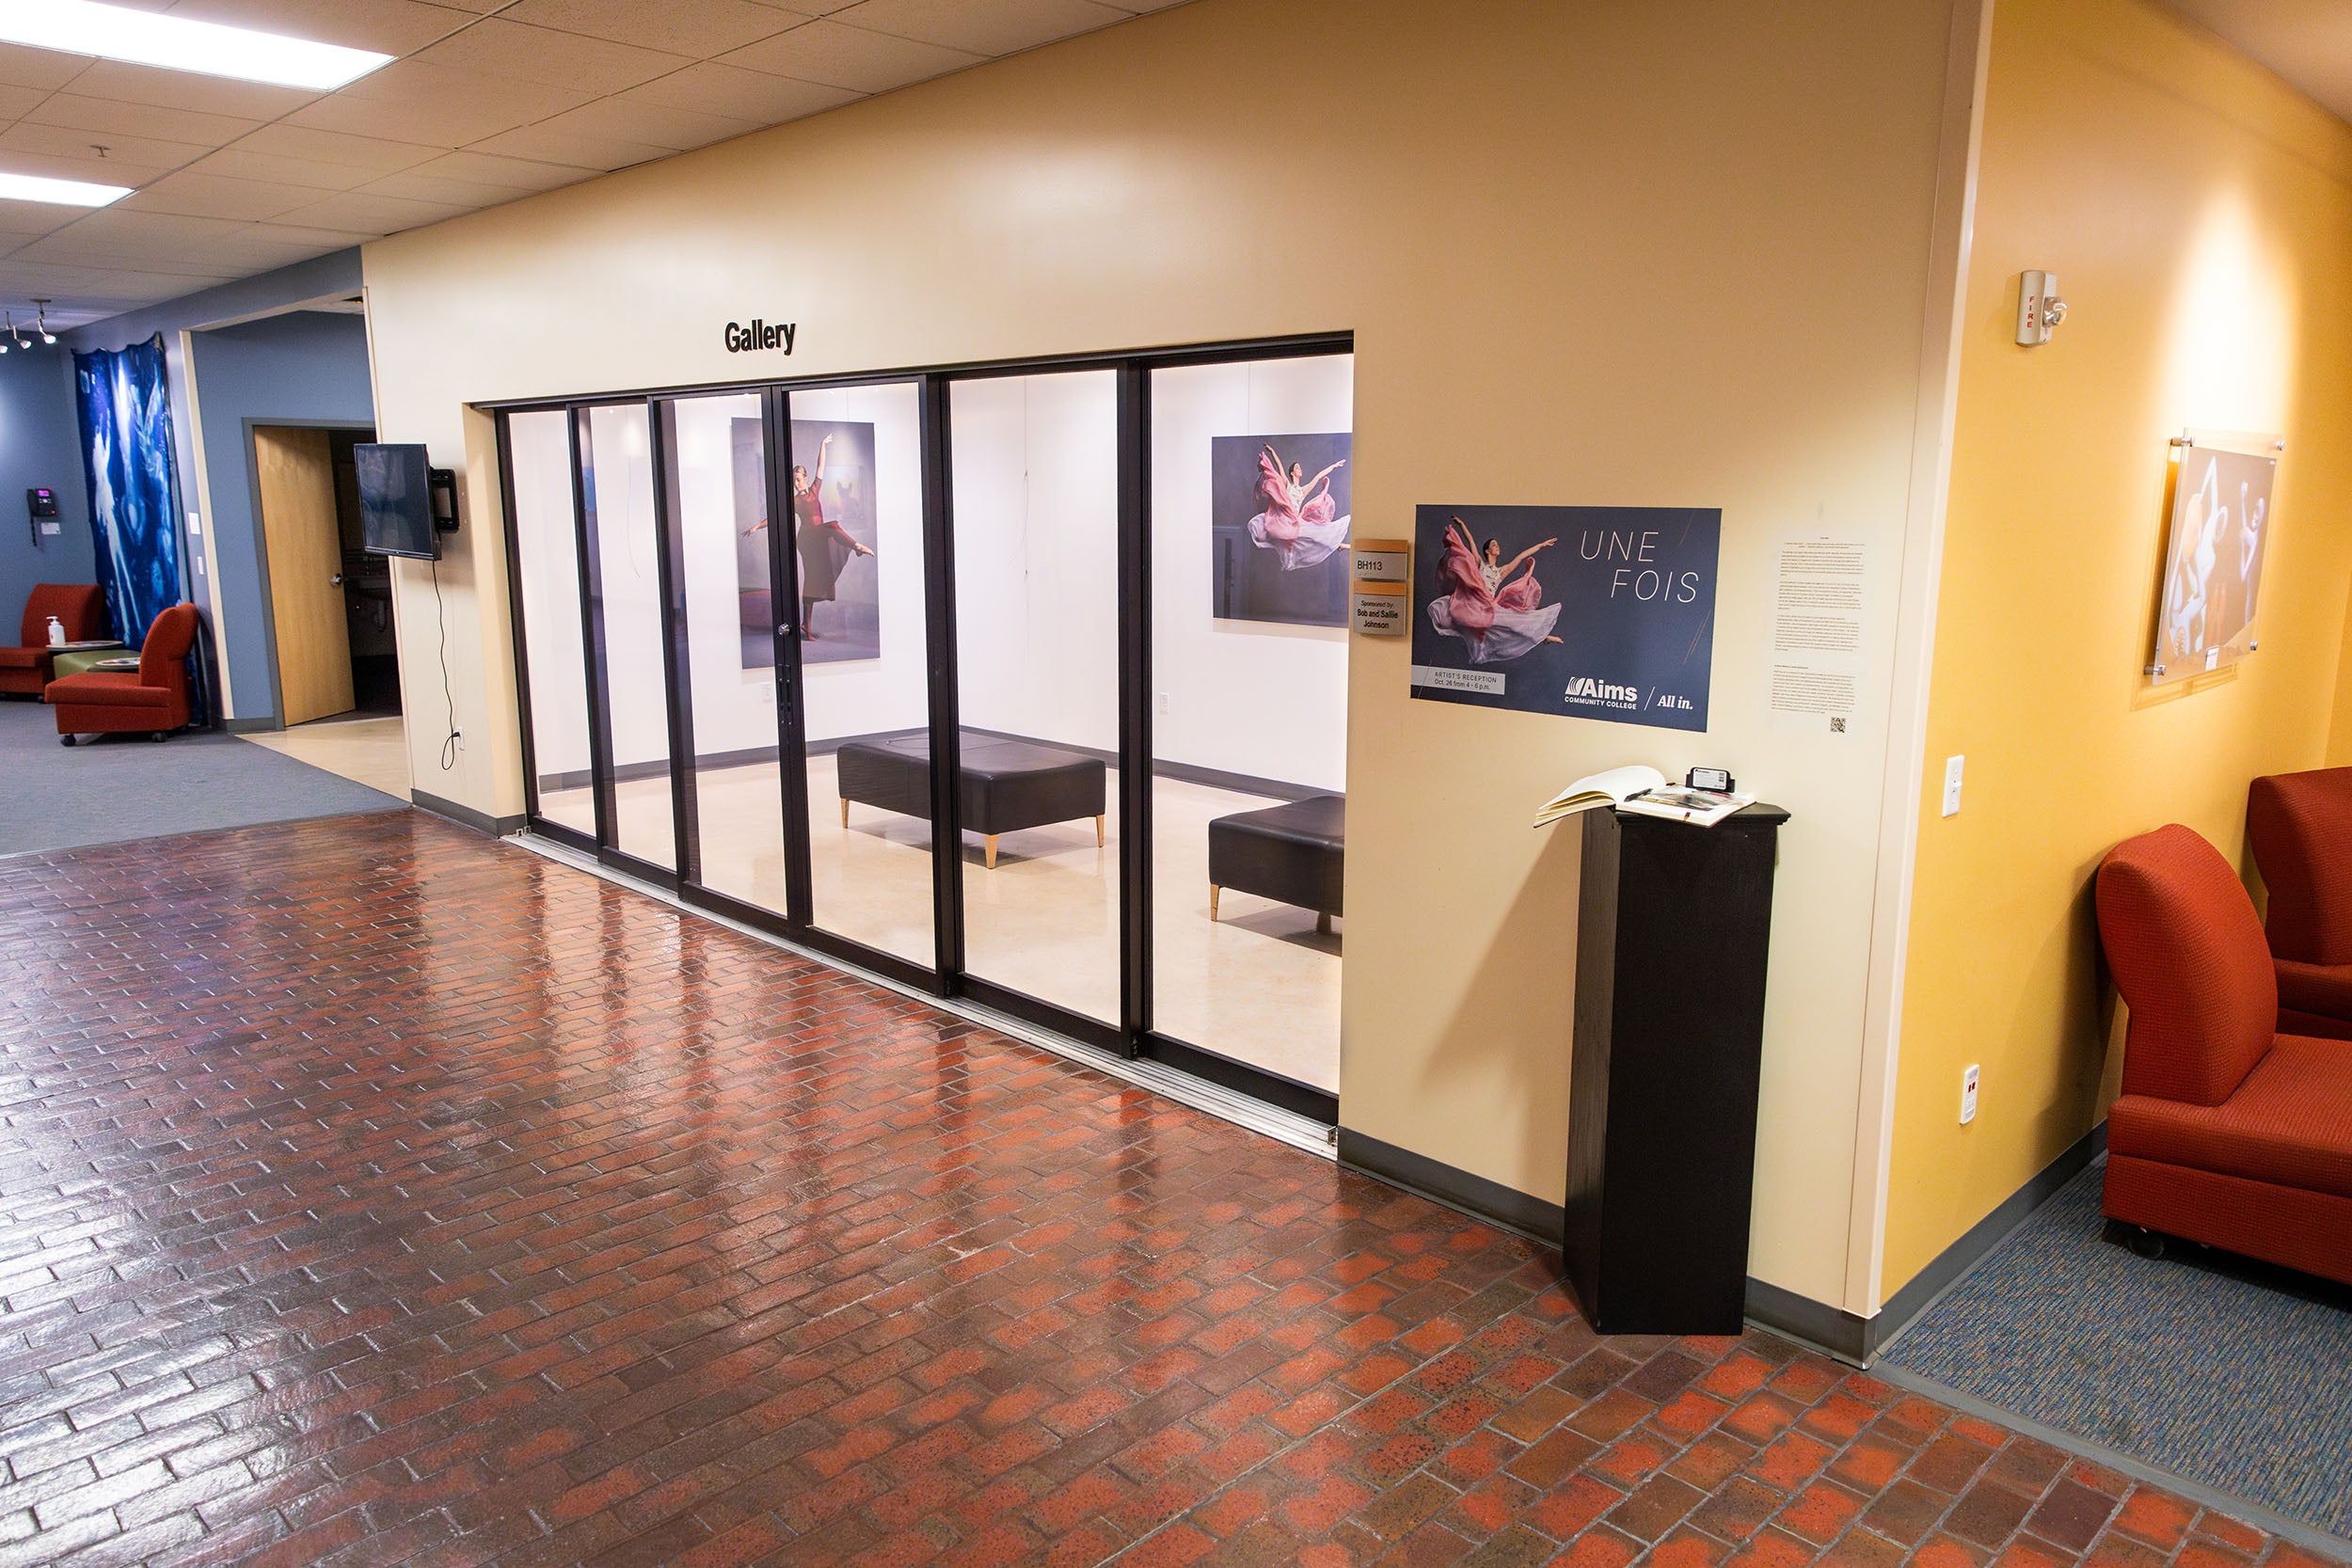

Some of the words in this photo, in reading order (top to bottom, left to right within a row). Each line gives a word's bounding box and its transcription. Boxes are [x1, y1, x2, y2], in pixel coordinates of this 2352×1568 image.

[2026, 295, 2035, 328] FIRE
[724, 319, 796, 356] Gallery
[1581, 530, 1660, 562] UNE
[1357, 560, 1383, 571] BH113
[1611, 568, 1699, 603] FOIS
[1357, 609, 1368, 617] Bob
[1369, 610, 1379, 618] and
[1363, 620, 1390, 629] Johnson
[1435, 671, 1461, 679] ARTIST'S
[1463, 673, 1497, 683] RECEPTION
[1581, 677, 1638, 702] Aims
[1564, 696, 1605, 706] COMMUNITY
[1606, 700, 1637, 710] COLLEGE
[1657, 694, 1675, 708] All
[1677, 696, 1693, 710] in.
